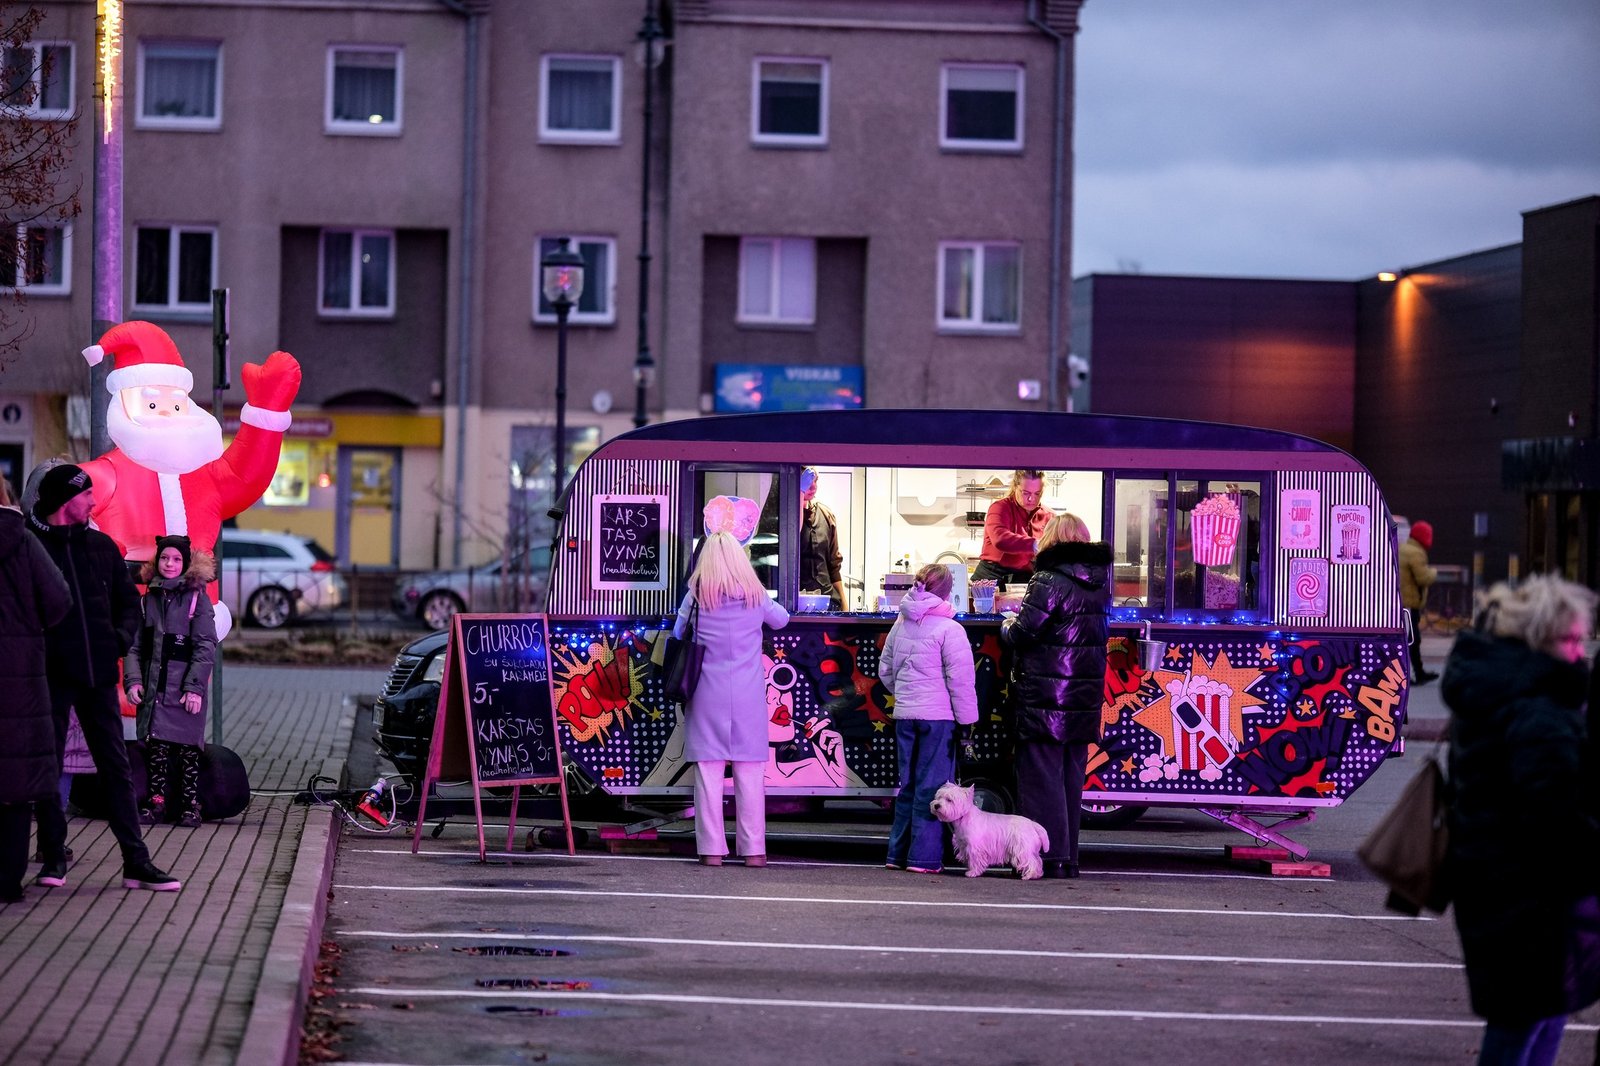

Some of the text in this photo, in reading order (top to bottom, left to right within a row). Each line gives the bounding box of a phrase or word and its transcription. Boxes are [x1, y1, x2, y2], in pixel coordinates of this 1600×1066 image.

[1291, 507, 1312, 521] CANDY
[1336, 512, 1365, 525] POPCORN
[602, 527, 637, 541] TAS
[602, 543, 656, 560] VYNAS
[1292, 562, 1326, 576] CANDIES
[467, 622, 542, 655] CHURROS
[558, 646, 632, 733] POW!
[1357, 658, 1407, 743] BAM!
